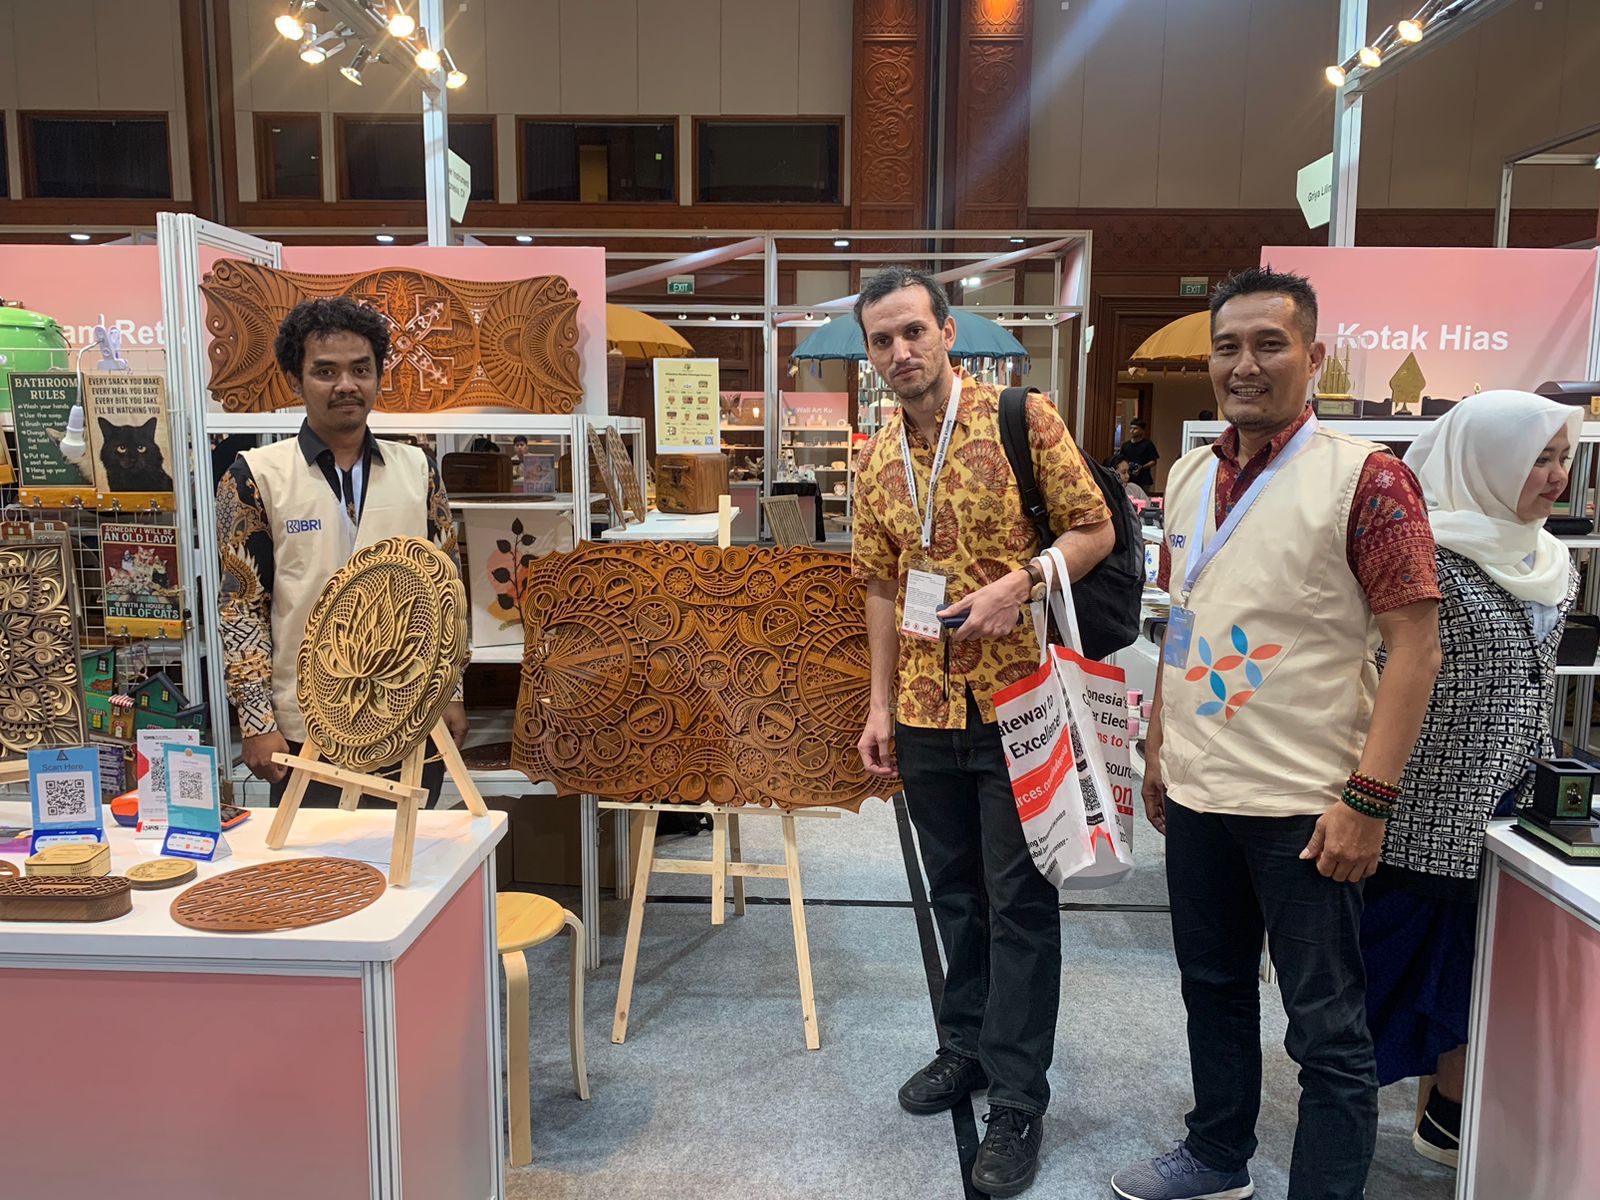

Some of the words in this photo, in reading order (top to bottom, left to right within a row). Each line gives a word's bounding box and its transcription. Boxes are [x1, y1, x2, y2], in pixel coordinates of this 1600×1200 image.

[674, 283, 688, 292] EXIT
[1186, 285, 1201, 294] EXIT
[115, 319, 187, 345] Ret
[1336, 322, 1429, 350] Kotak
[1439, 324, 1509, 351] Hias
[14, 377, 78, 388] BATHROOM
[88, 377, 107, 386] EVERY
[109, 377, 129, 386] SNACK
[130, 377, 142, 385] YOU
[143, 377, 160, 386] MAKE
[30, 389, 66, 400] RULES
[91, 387, 110, 395] EVERY
[112, 387, 128, 395] MEAL
[129, 387, 142, 395] YOU
[143, 387, 159, 395] BAKE
[95, 397, 113, 405] EVERY
[115, 397, 128, 405] BITE
[129, 397, 142, 405] YOU
[143, 397, 158, 405] TAKE
[107, 406, 115, 414] BE
[116, 406, 147, 414] WATCHING
[148, 406, 160, 414] YOU
[105, 525, 137, 533] SOMEDAY
[300, 519, 322, 532] BRI
[104, 532, 119, 541] AN
[121, 533, 144, 542] OLD
[145, 534, 174, 544] LADY
[1168, 534, 1187, 549] BRI
[109, 606, 137, 617] FULL
[137, 608, 151, 618] OF
[153, 609, 179, 619] CATS
[1111, 734, 1123, 748] to
[42, 763, 62, 771] Scan
[64, 762, 84, 770] Here
